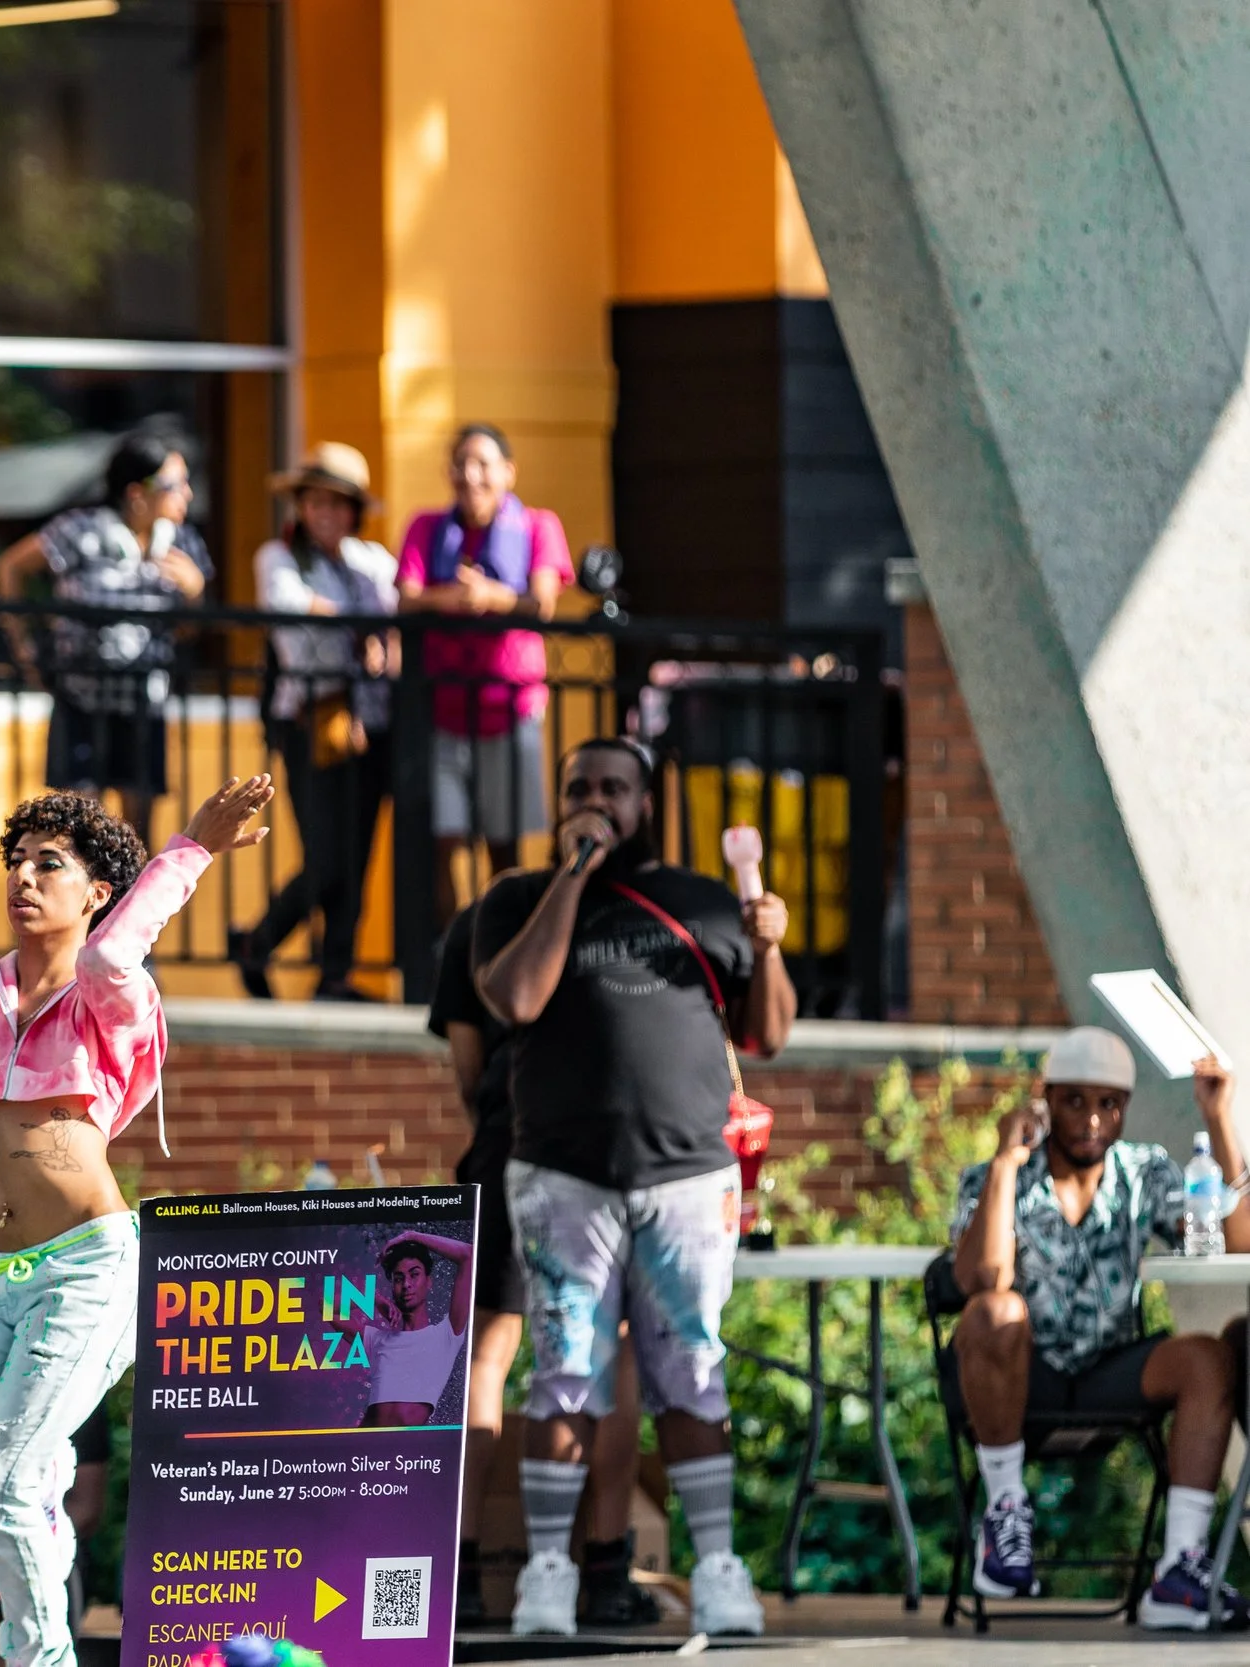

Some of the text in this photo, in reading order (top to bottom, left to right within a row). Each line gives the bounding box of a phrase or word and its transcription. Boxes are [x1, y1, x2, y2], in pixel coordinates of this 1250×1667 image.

[155, 1195, 462, 1216] CALLING ALL Ballroom Houses, Kiki Houses and Modeling Troupes!
[158, 1249, 338, 1271] MONTGOMERY COUNTY
[155, 1274, 376, 1328] PRIDE IN
[156, 1332, 370, 1375] THE PLAZA
[152, 1386, 258, 1410] FREE BALL
[151, 1462, 217, 1478] Veteran's
[221, 1460, 259, 1476] Plaza
[272, 1459, 347, 1475] Downtown
[350, 1456, 391, 1472] Silver
[395, 1455, 441, 1474] Spring
[179, 1486, 235, 1504] Sunday,
[239, 1485, 274, 1500] June
[278, 1486, 294, 1500] 27
[299, 1485, 346, 1499] 5:00PM
[359, 1483, 408, 1496] 8:00PM
[152, 1548, 303, 1572] SCAN HERE TO
[151, 1583, 257, 1605] CHECK-IN!
[148, 1615, 287, 1643] ESCANEE AQUÍ
